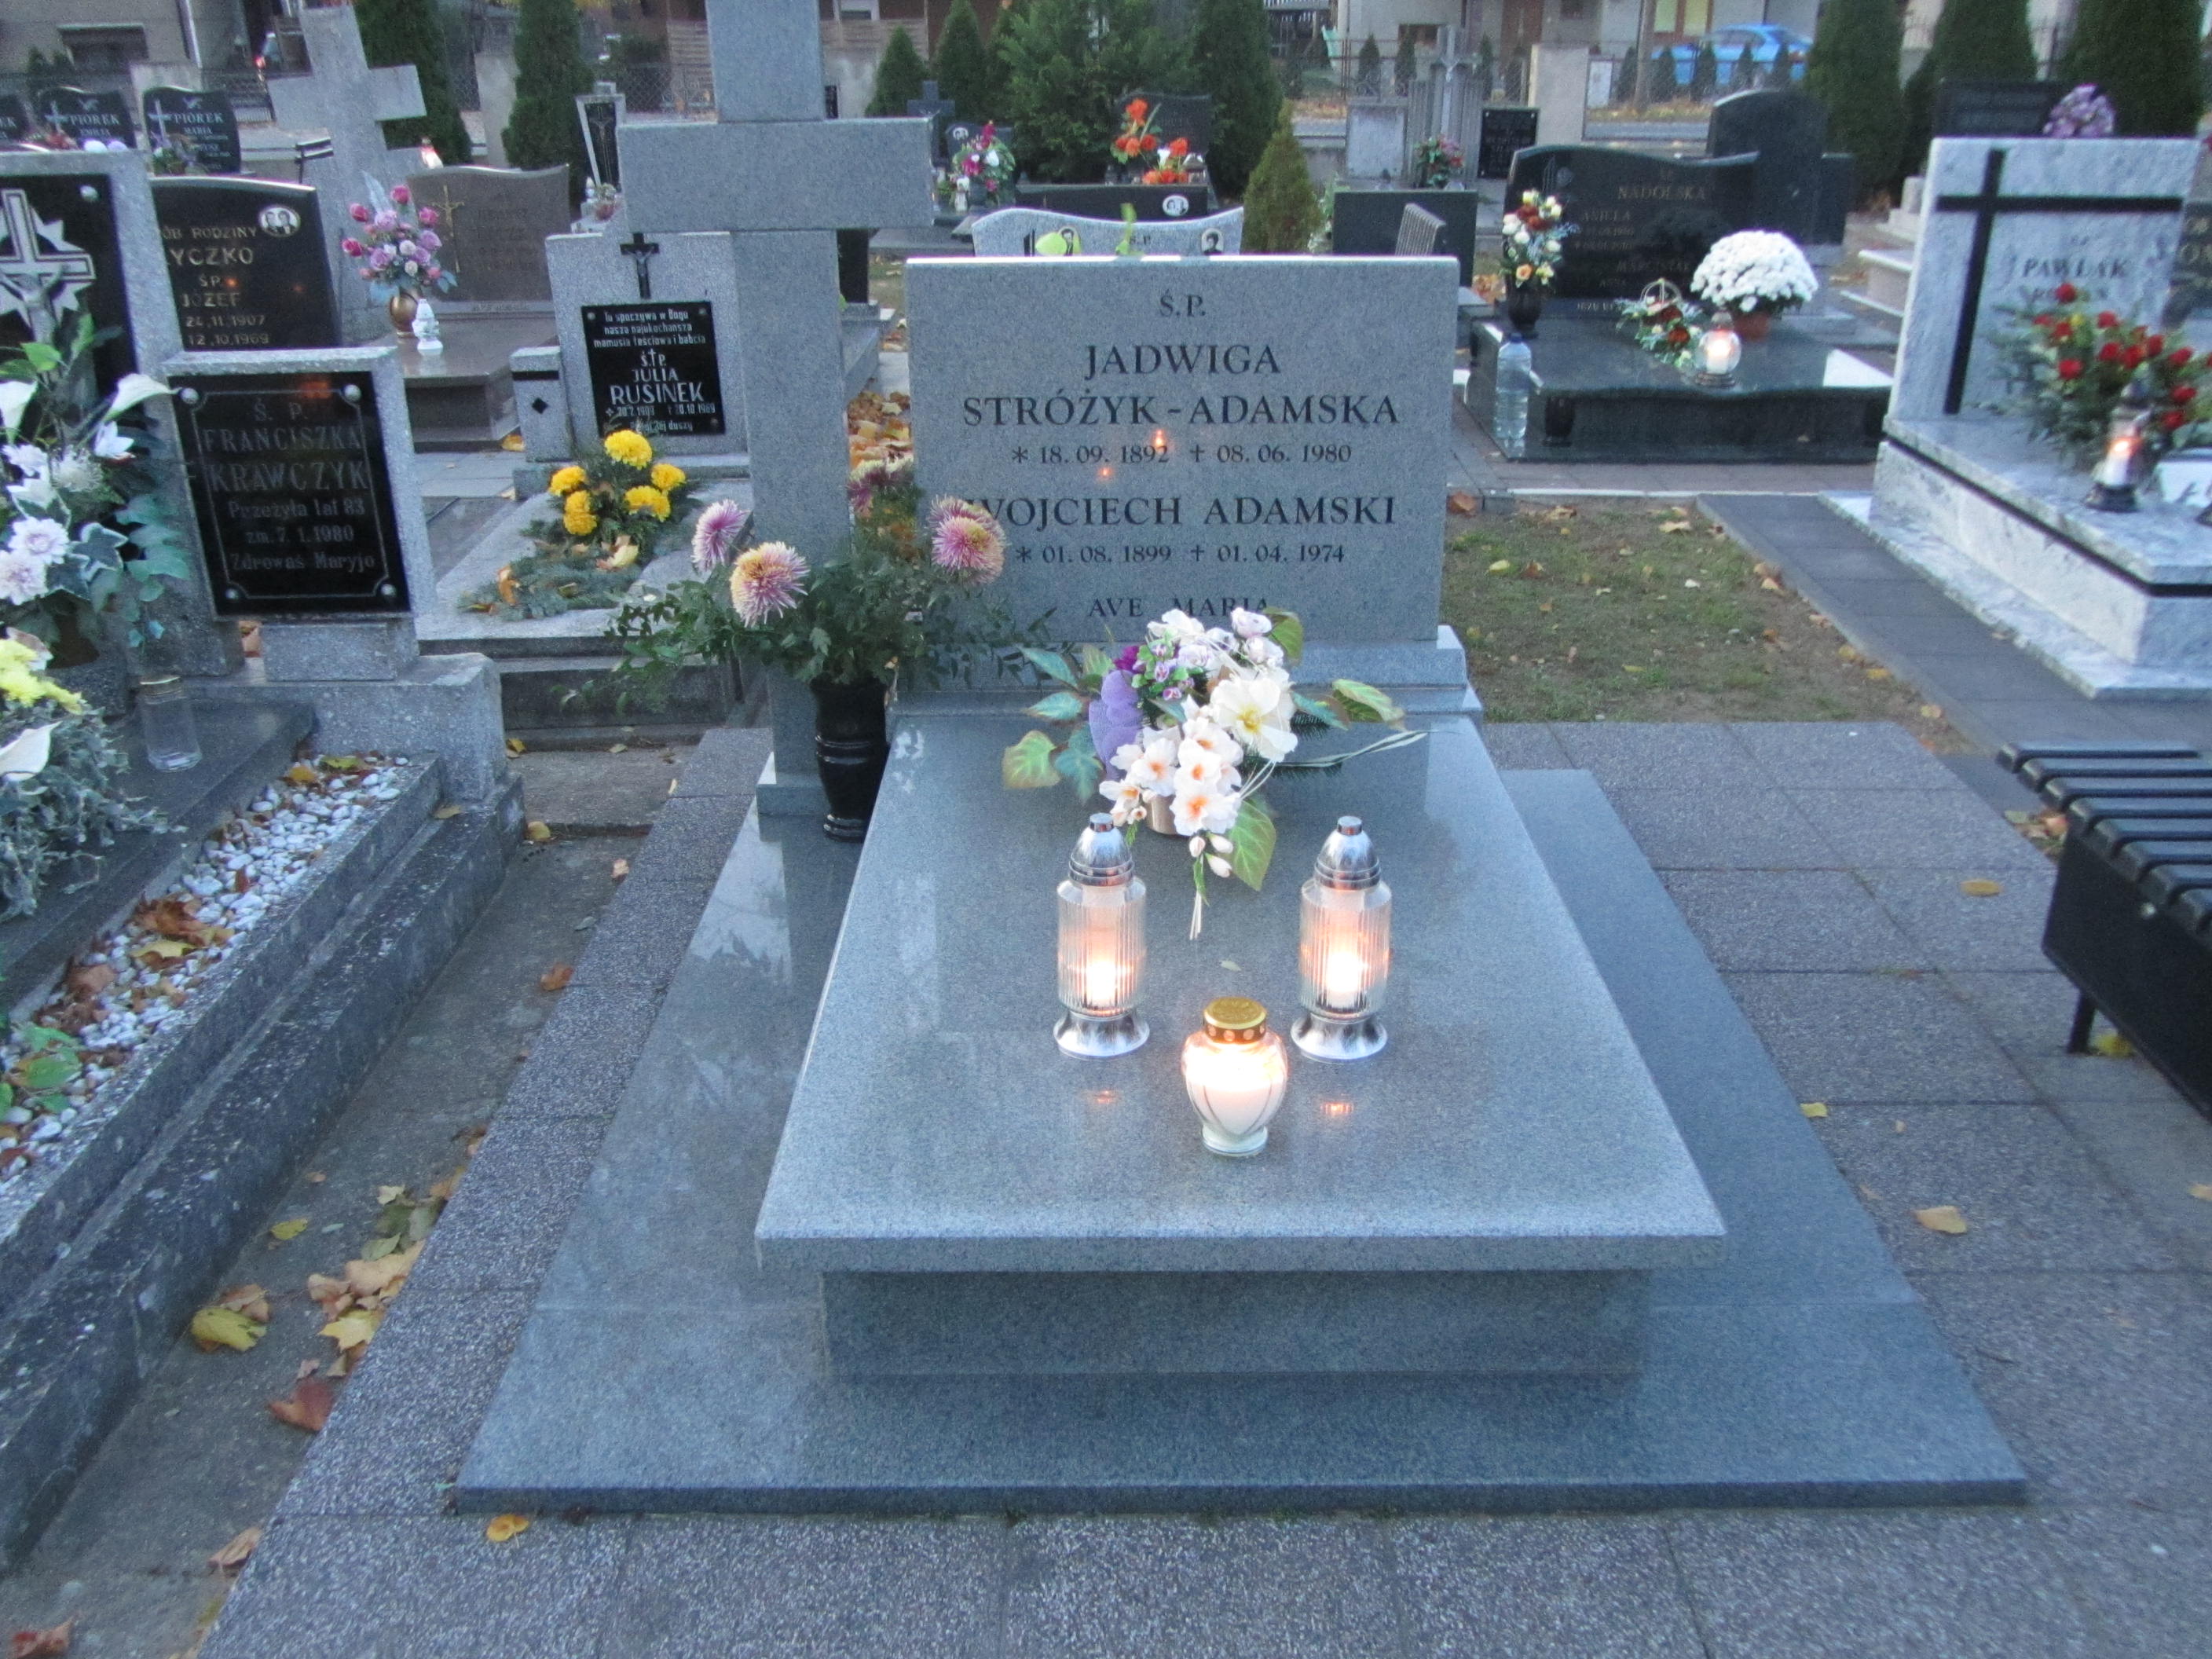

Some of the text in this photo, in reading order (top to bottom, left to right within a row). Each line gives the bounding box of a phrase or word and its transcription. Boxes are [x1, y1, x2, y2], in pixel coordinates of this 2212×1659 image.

[191, 225, 257, 239] RODZINY
[169, 247, 255, 266] YCZKO
[1084, 343, 1281, 381] JADWIGA
[632, 368, 679, 383] JULIA
[610, 382, 705, 405] RUSINEK
[203, 426, 363, 452] FRANCISZKA
[1121, 445, 1170, 464] 1892
[1302, 444, 1353, 463] 1980
[207, 460, 370, 493] KRAWCZYK
[313, 498, 340, 517] lat
[1203, 496, 1396, 526] ADAMSKI
[314, 552, 375, 573] Maryjo
[1123, 545, 1172, 564] 1899
[1299, 544, 1345, 563] 1974
[1090, 597, 1144, 618] AVE
